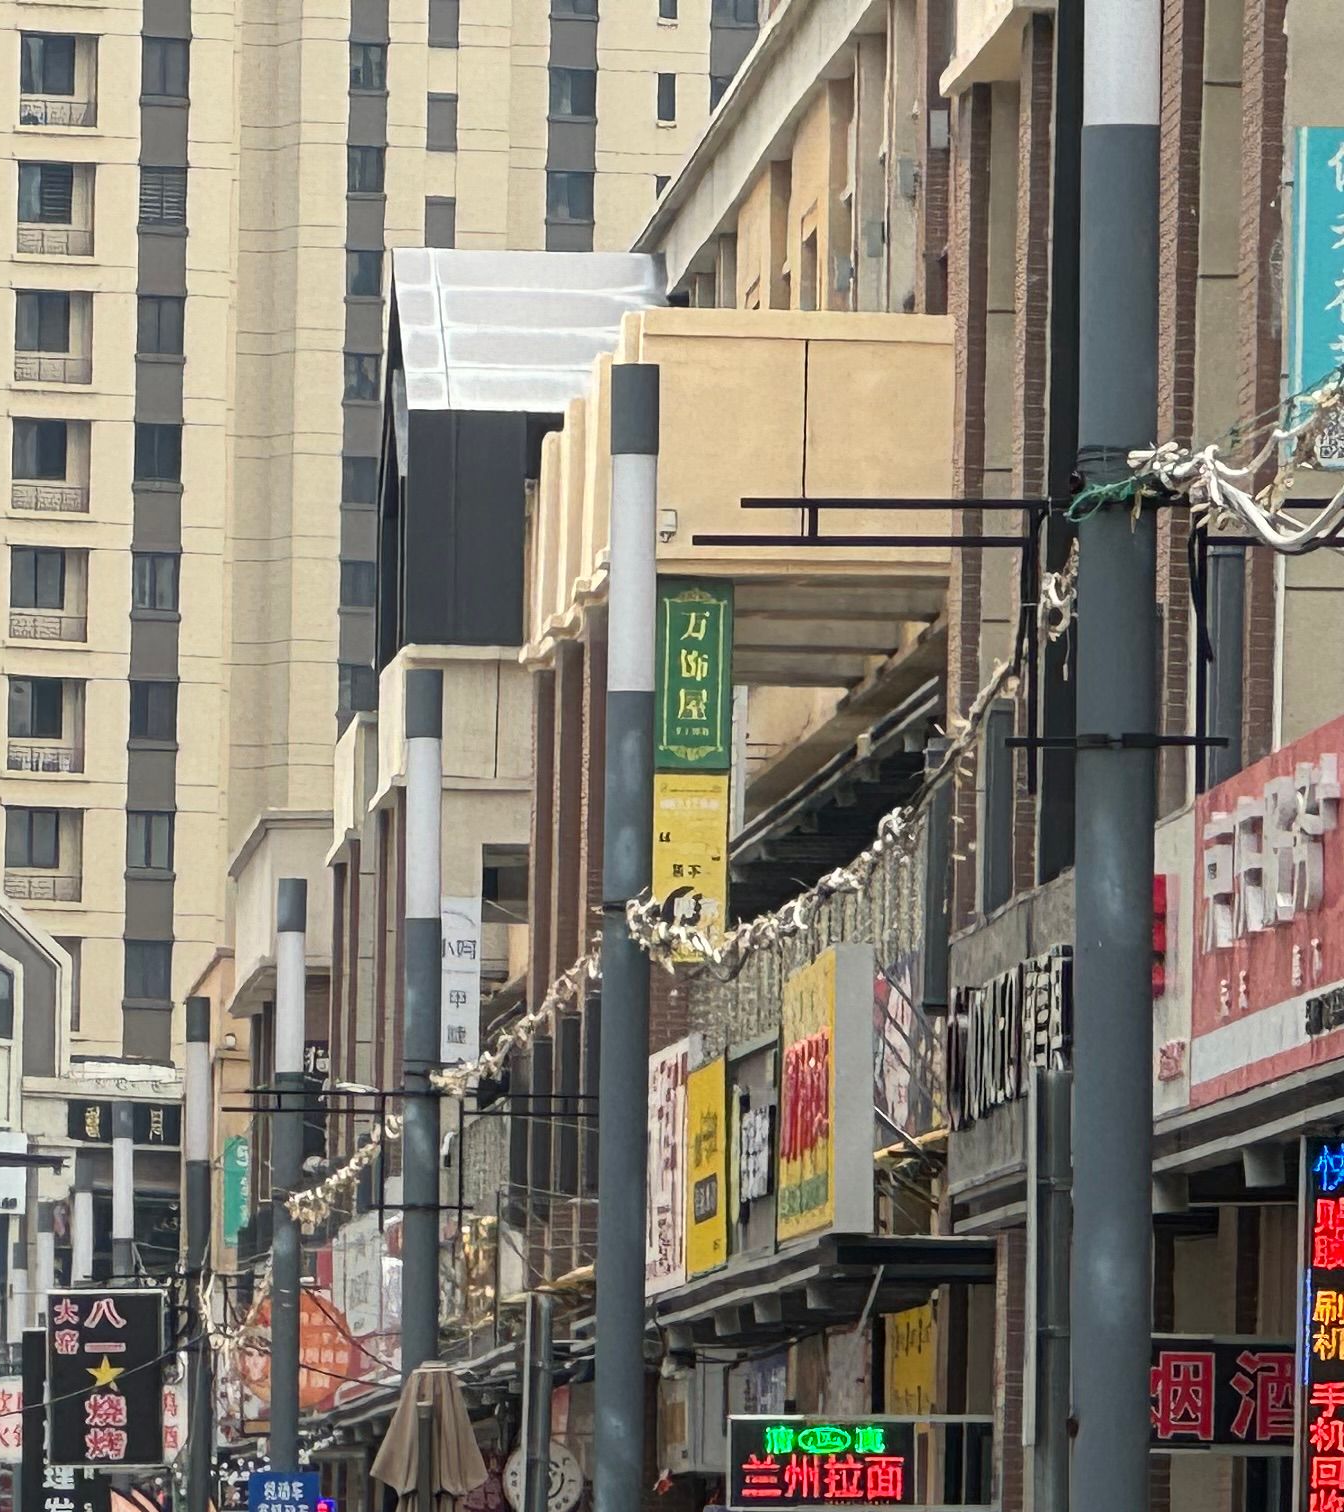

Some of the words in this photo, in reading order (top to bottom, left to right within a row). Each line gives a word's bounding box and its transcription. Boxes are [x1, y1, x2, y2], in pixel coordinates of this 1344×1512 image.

[84, 1394, 128, 1461] 烧烤
[1150, 1351, 1296, 1441] 烟酒
[741, 1454, 905, 1501] 兰州拉面
